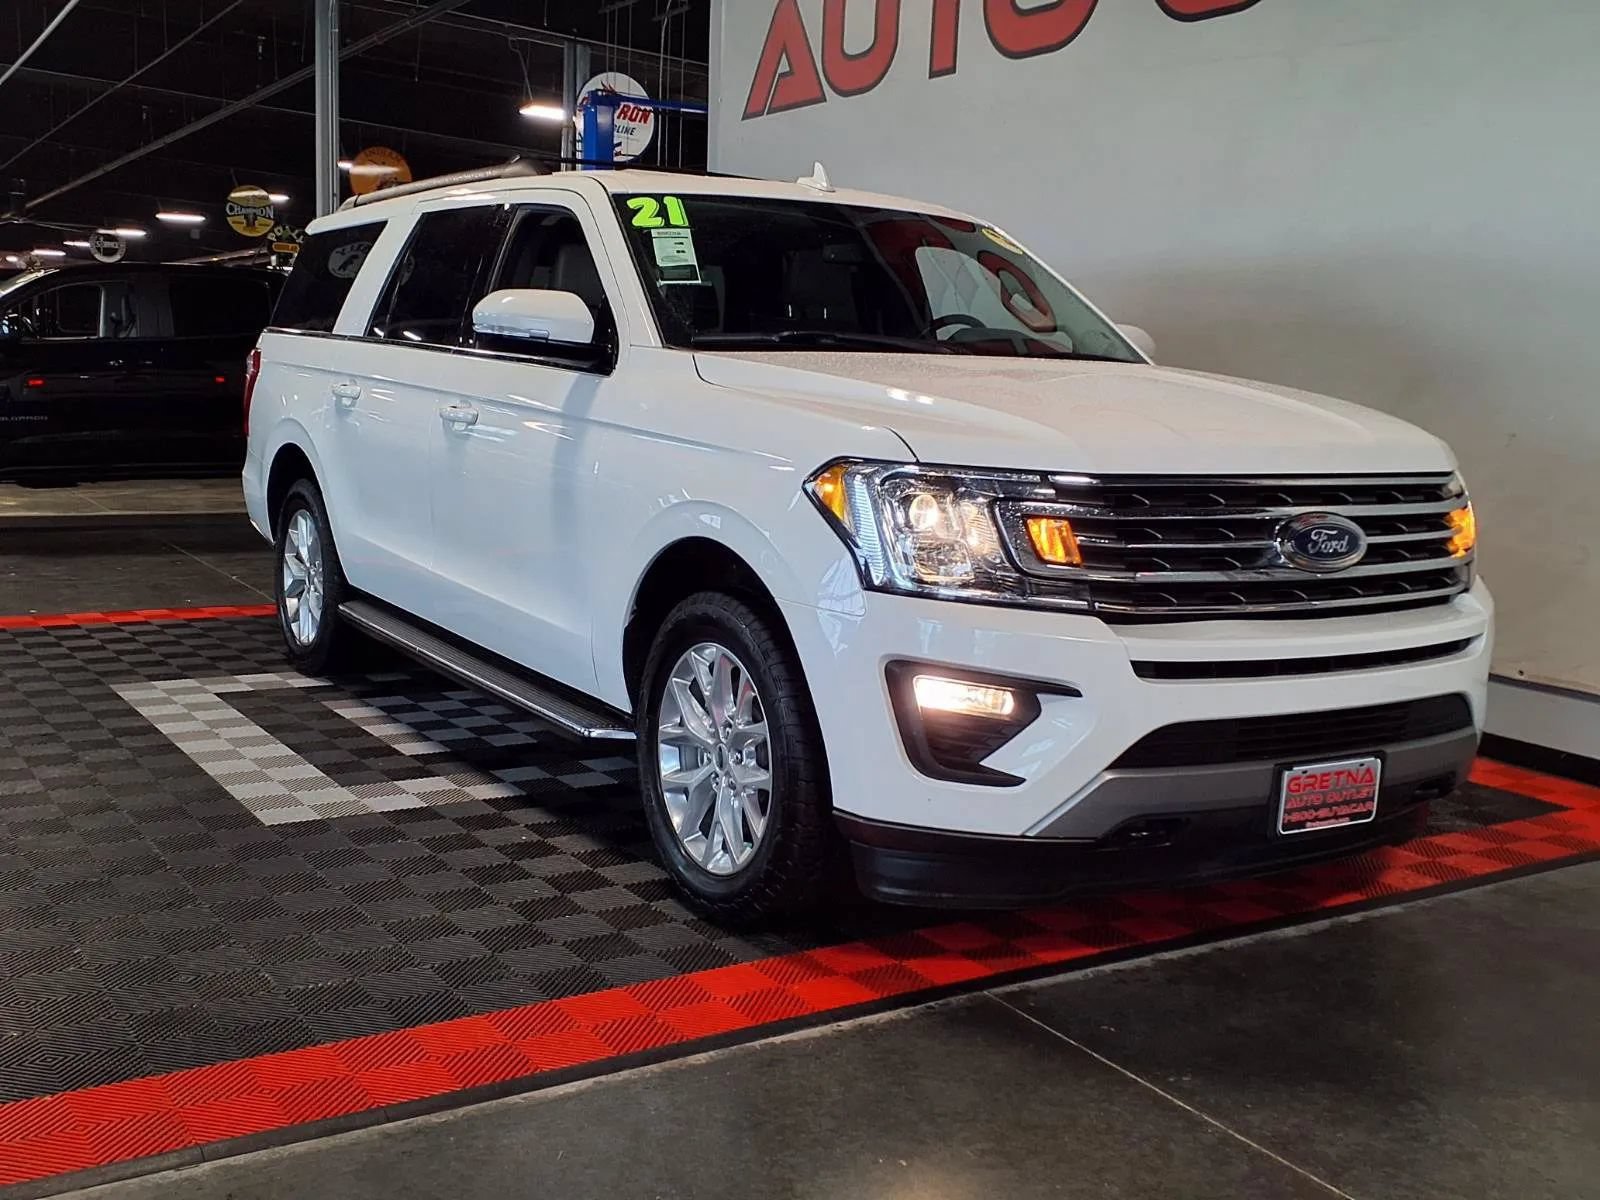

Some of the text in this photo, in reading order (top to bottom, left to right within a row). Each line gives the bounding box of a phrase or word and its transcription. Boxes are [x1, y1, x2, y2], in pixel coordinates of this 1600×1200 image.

[626, 195, 689, 228] 21
[1307, 529, 1349, 554] Ford
[1287, 768, 1375, 794] GRETNA
[1286, 787, 1375, 808] AUTO OUTLET
